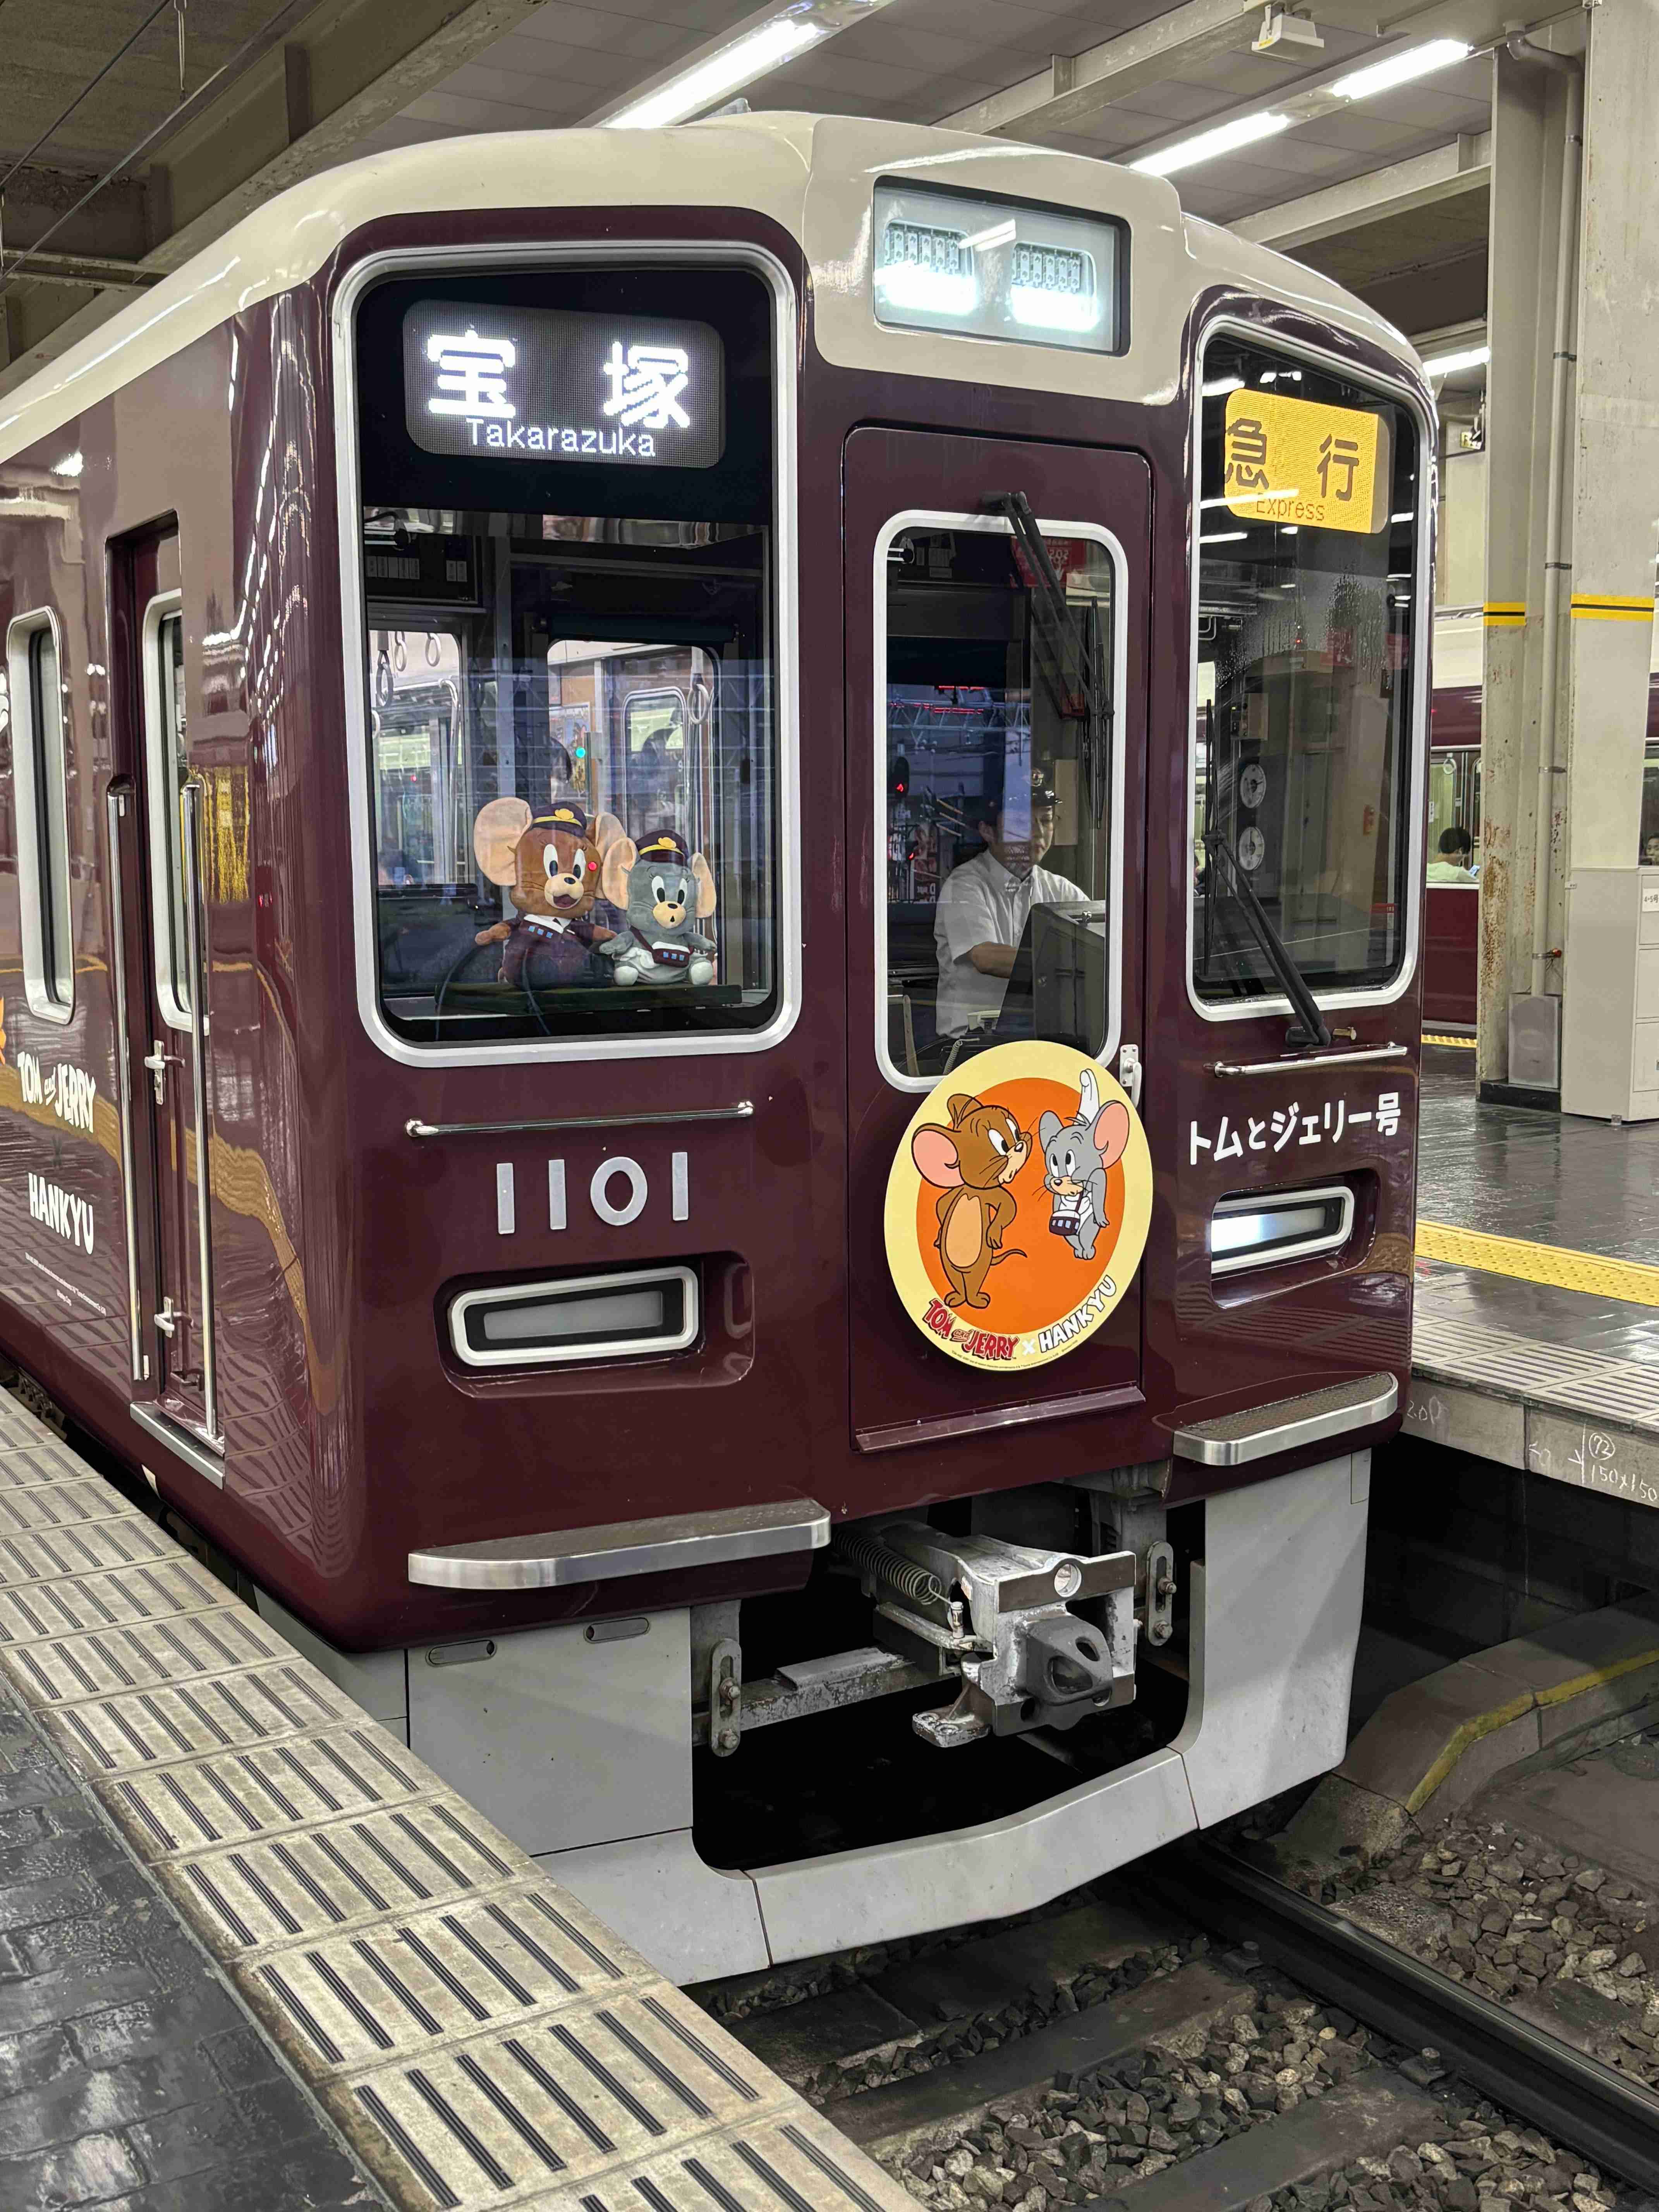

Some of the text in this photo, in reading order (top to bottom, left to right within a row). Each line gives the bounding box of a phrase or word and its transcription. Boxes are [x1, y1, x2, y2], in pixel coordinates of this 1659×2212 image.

[427, 330, 690, 429] 宝塚
[466, 418, 656, 457] Takarazuka
[1224, 418, 1359, 501] 急行
[1256, 494, 1324, 522] Express
[17, 1051, 43, 1104] TOM
[55, 1063, 96, 1133] JERRY
[1190, 1092, 1401, 1165] トムとジェリー号
[28, 1172, 94, 1255] HANKYU
[496, 1151, 689, 1234] 1101
[922, 1298, 957, 1340] TOM
[961, 1329, 1020, 1361] JERRY
[1038, 1274, 1117, 1353] HANKYU
